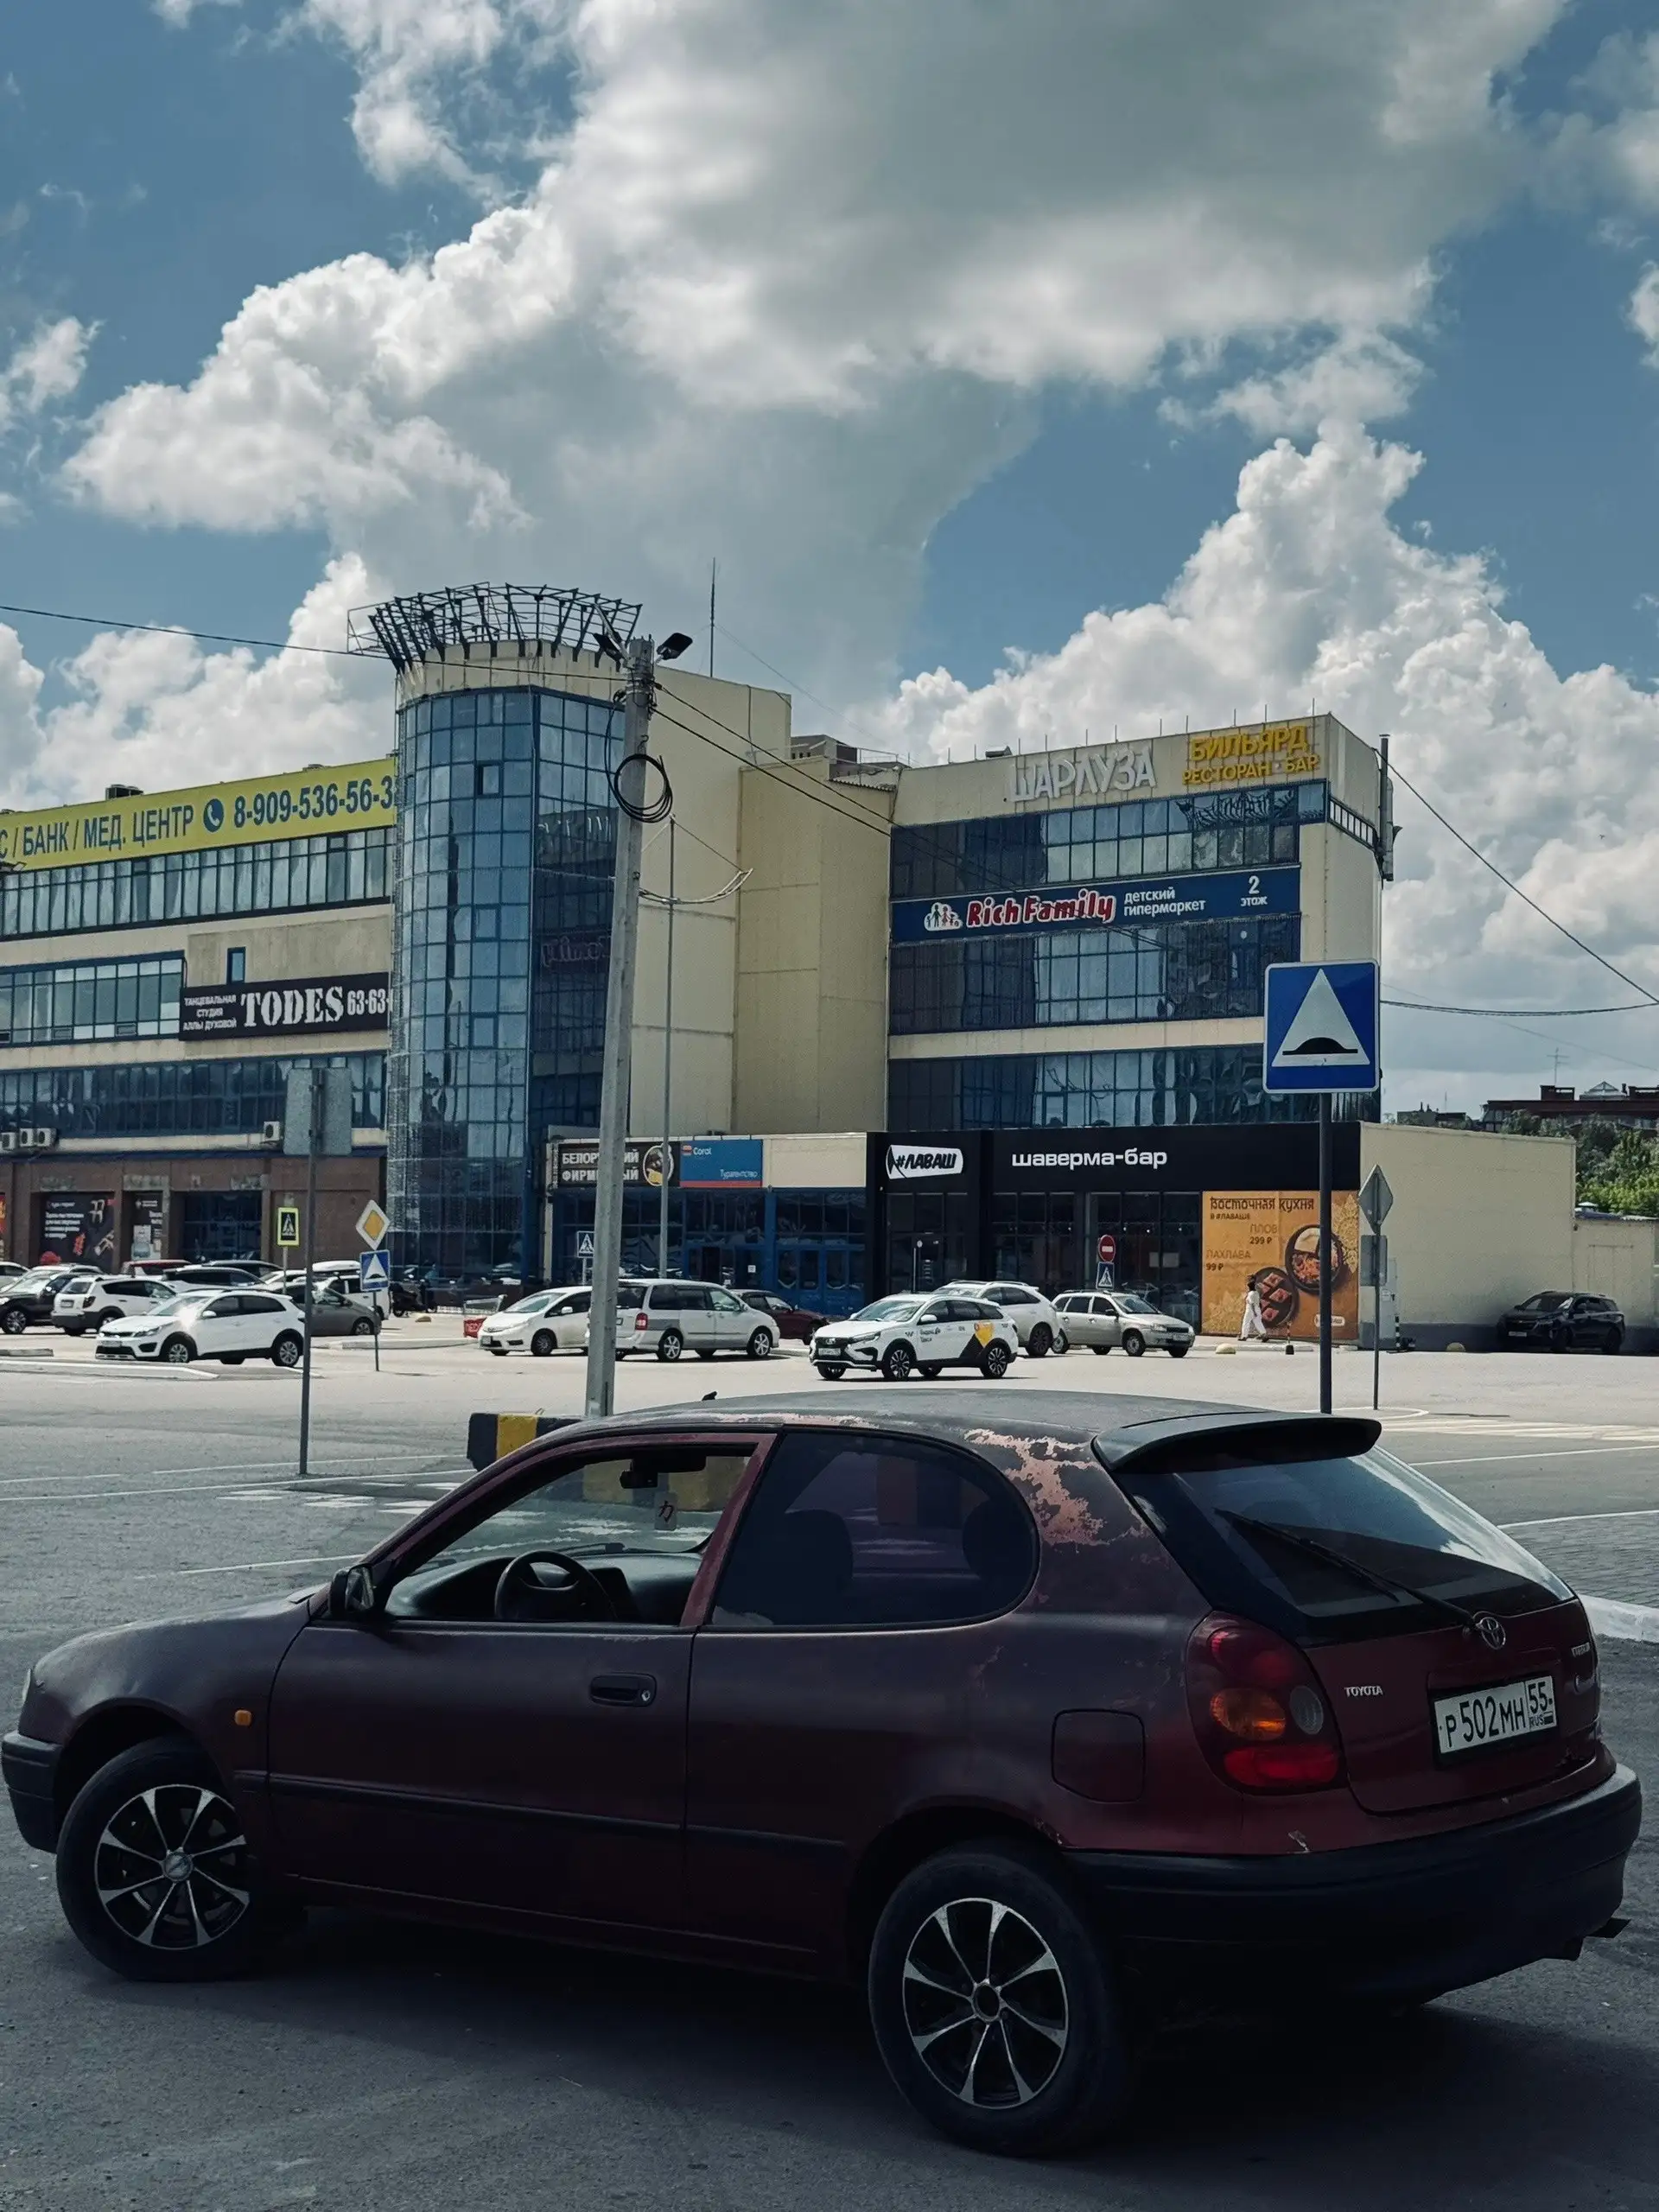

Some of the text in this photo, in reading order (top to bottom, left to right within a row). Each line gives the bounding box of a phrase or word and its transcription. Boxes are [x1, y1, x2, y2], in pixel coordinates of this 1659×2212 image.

[1190, 726, 1309, 761] БИЛЬЯРД
[1181, 753, 1320, 785] РЕСТОРАН БАР
[22, 822, 70, 856] БАНК
[84, 814, 127, 852] МЕД.
[132, 804, 194, 849] ЦЕНТР
[234, 775, 399, 828] 8-909-536-56-3
[1248, 875, 1260, 894] 2
[1123, 887, 1176, 906] детский
[1240, 896, 1268, 907] этаж
[966, 888, 1116, 927] Rich Family
[1123, 899, 1206, 918] гипермаркет
[196, 1007, 223, 1018] СТУДИЯ
[241, 986, 344, 1027] TODES
[896, 1153, 957, 1169] #ЛАВАШ
[1012, 1147, 1167, 1170] шаверма-бар
[1249, 1224, 1278, 1234] ПЛОВ
[1206, 1249, 1251, 1260] ПАХЛАВА
[1345, 1686, 1382, 1697] TOYOTA
[1529, 1681, 1547, 1712] 55
[1529, 1714, 1543, 1726] RUS
